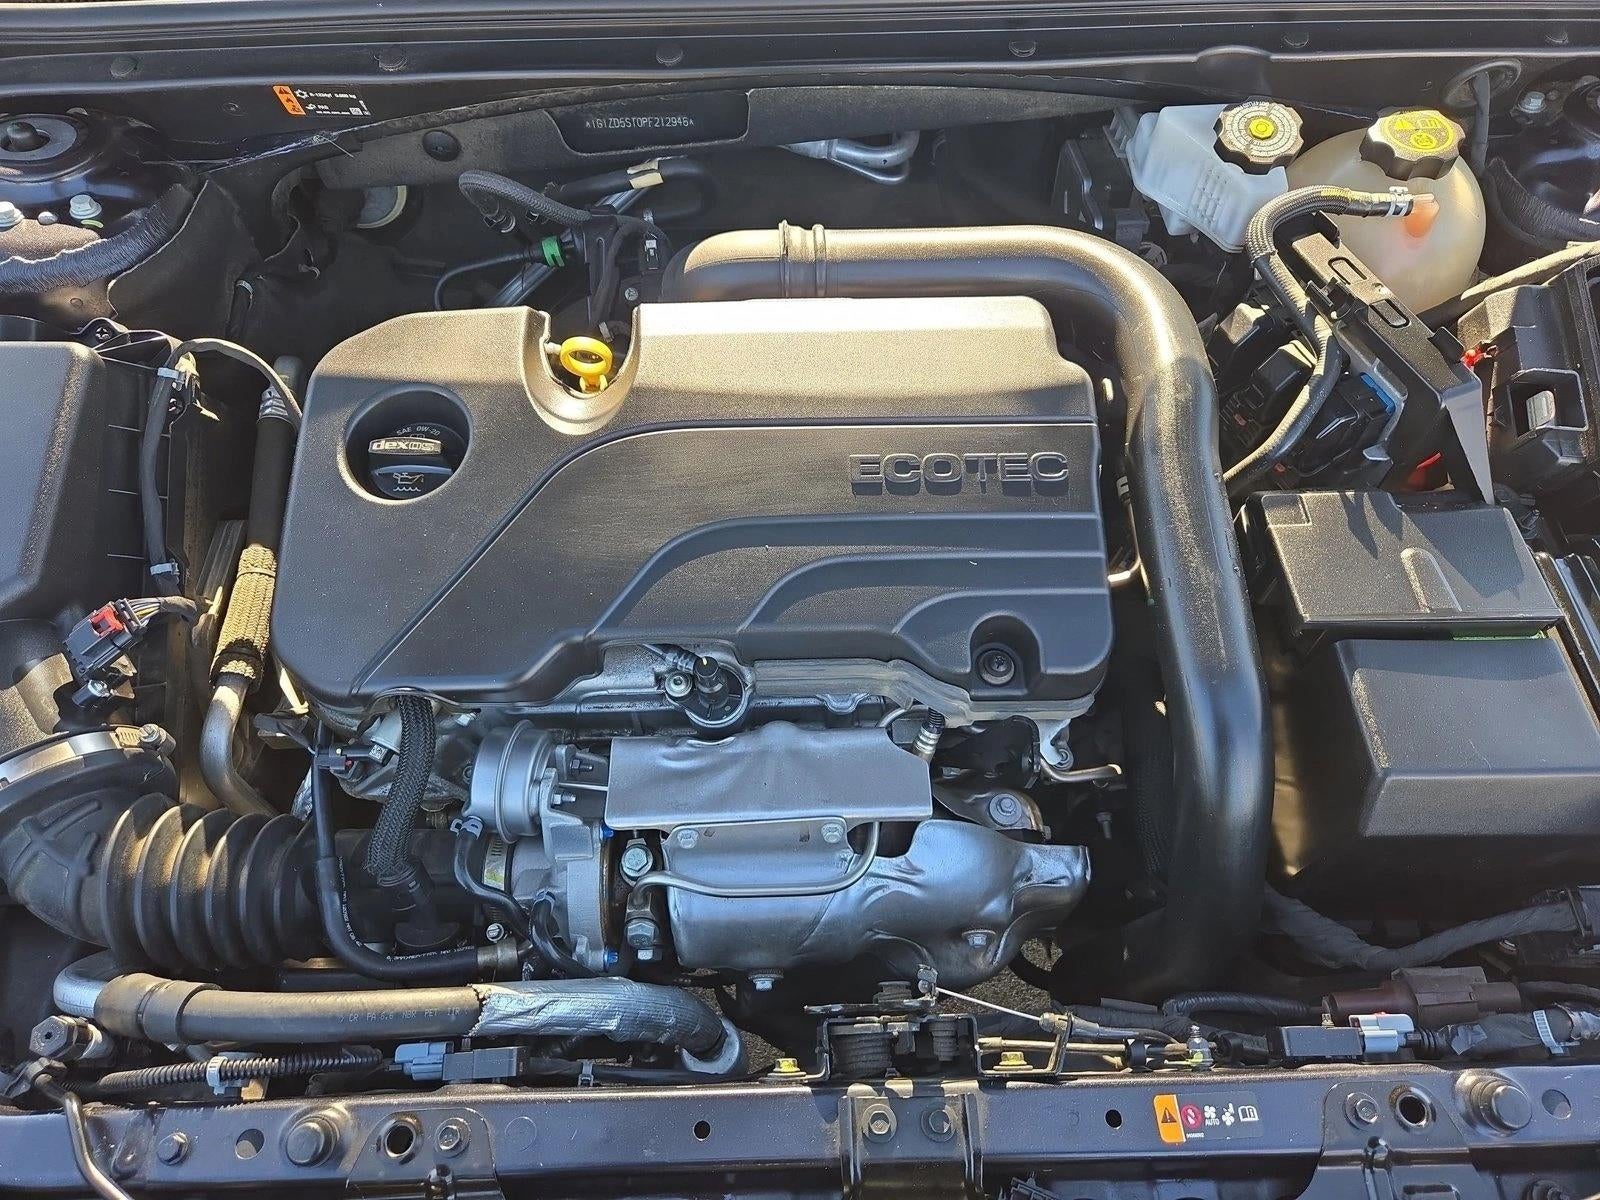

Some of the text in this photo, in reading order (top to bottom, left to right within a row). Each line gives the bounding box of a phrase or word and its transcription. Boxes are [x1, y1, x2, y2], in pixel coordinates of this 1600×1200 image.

[396, 426, 412, 436] SAE
[372, 440, 435, 451] dexos
[849, 451, 1069, 495] ECOTEC
[366, 1012, 376, 1021] PA
[1205, 1118, 1220, 1126] AUTO
